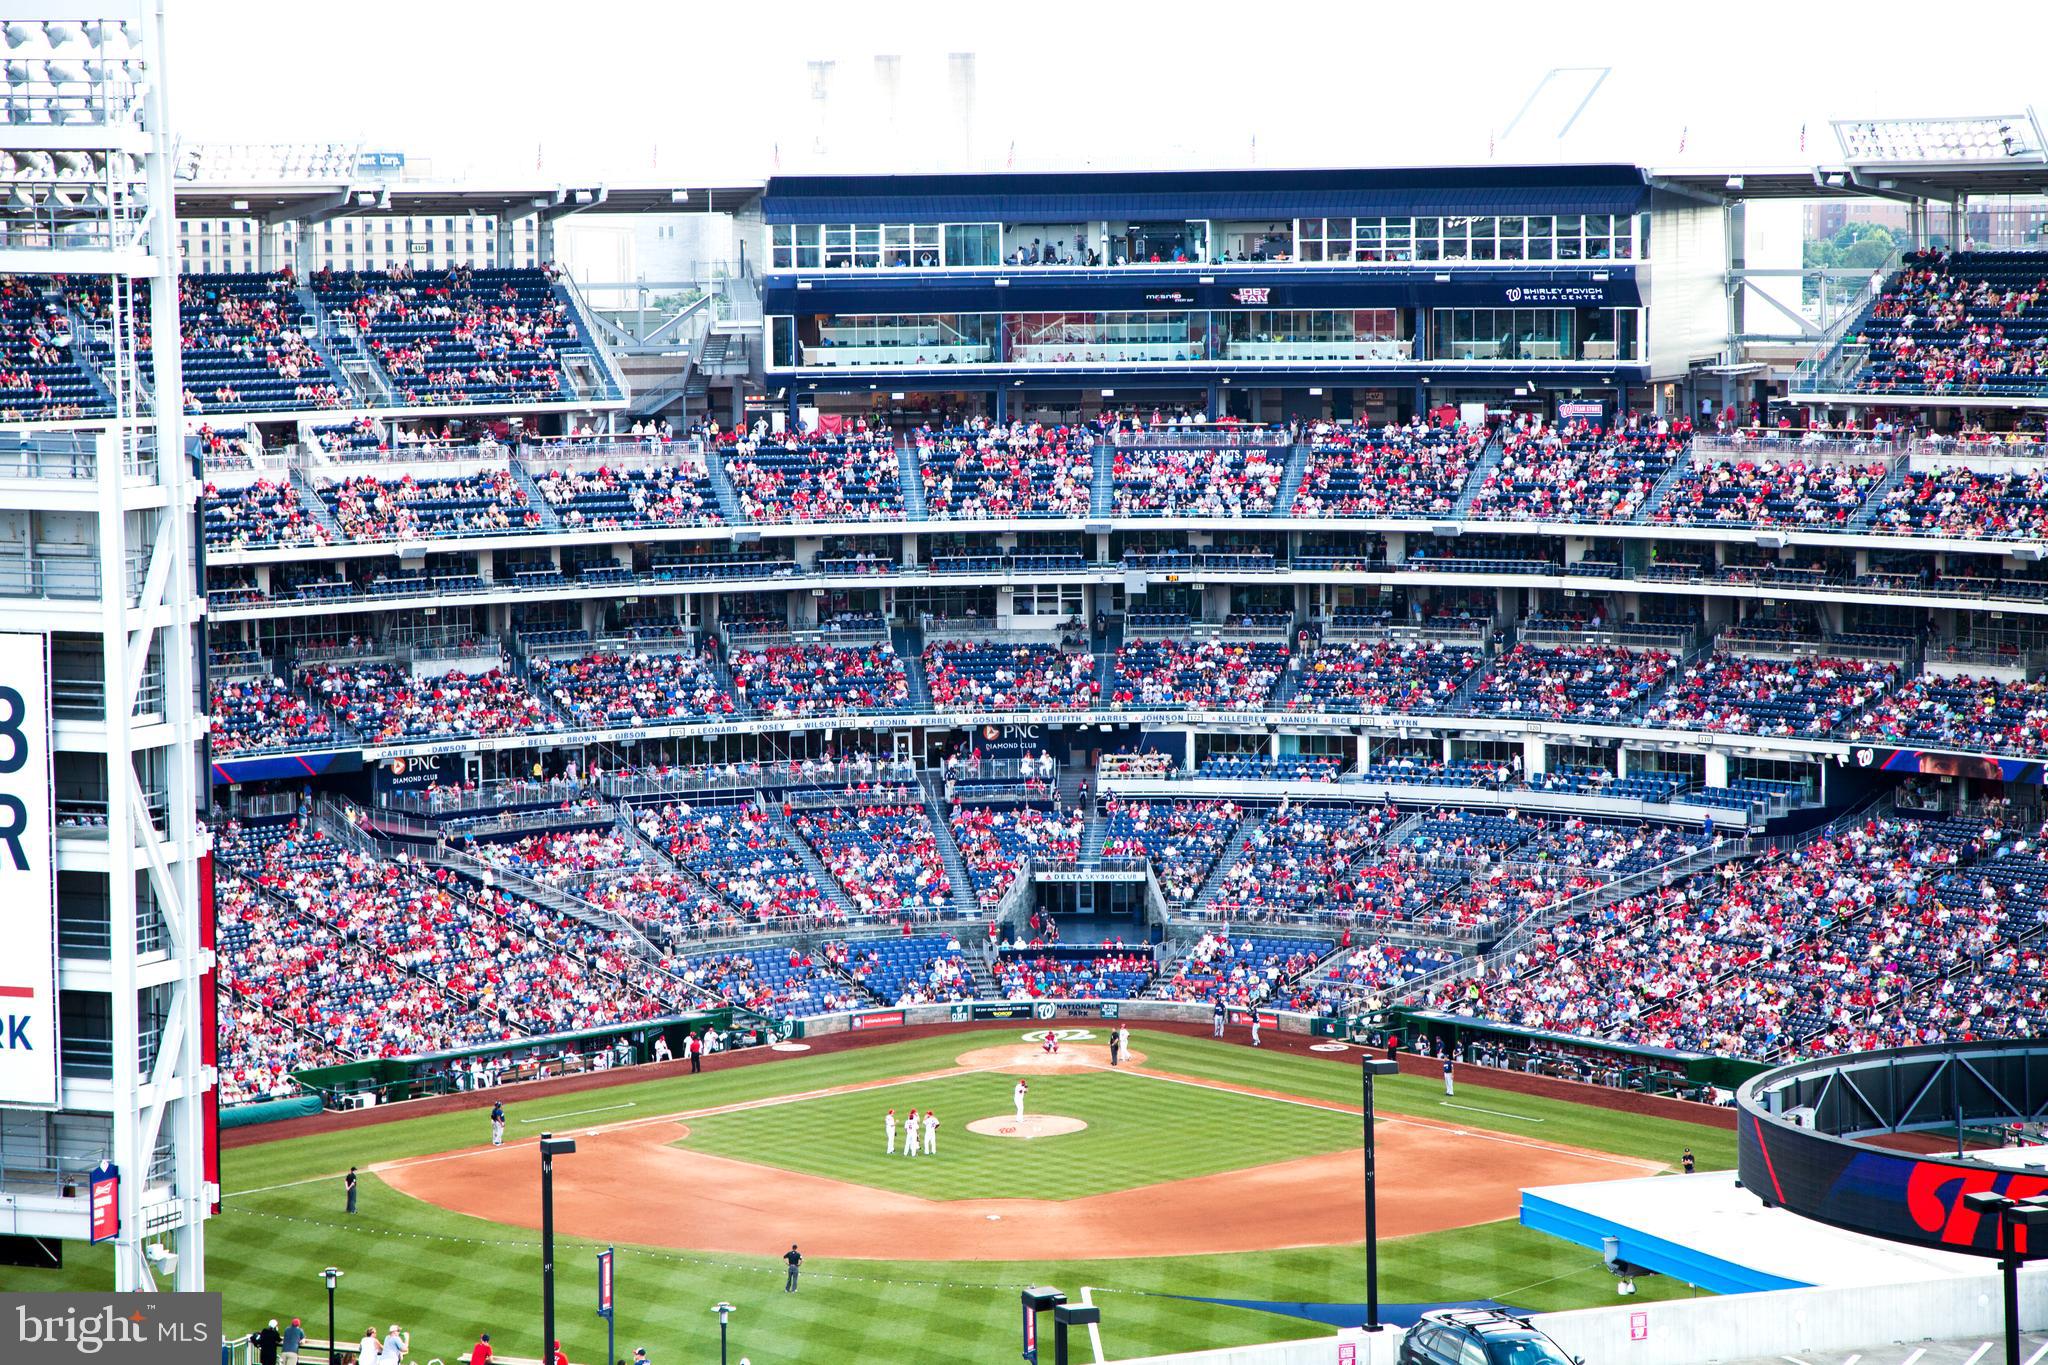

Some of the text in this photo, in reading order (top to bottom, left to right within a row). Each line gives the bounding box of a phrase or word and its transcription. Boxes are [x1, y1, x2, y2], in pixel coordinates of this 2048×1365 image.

[1574, 405, 1586, 413] TEAM
[1587, 405, 1602, 413] STORE
[920, 717, 959, 725] FERRELL
[1094, 714, 1128, 722] HARRIS
[1141, 714, 1184, 722] JOHNSON
[1218, 715, 1268, 723] KILLEBREW
[756, 723, 785, 731] POSEY
[803, 720, 837, 729] WILSON
[1392, 719, 1419, 727] WYNN
[697, 725, 738, 734] LEONARD
[1003, 725, 1040, 739] PNC
[566, 735, 597, 744] BROWN
[614, 731, 647, 740] GIBSON
[527, 738, 549, 746] BELL
[381, 748, 414, 758] CARTER
[431, 744, 467, 754] DAWSON
[408, 755, 441, 772] PNC
[392, 773, 438, 784] DIAMOND CLUB
